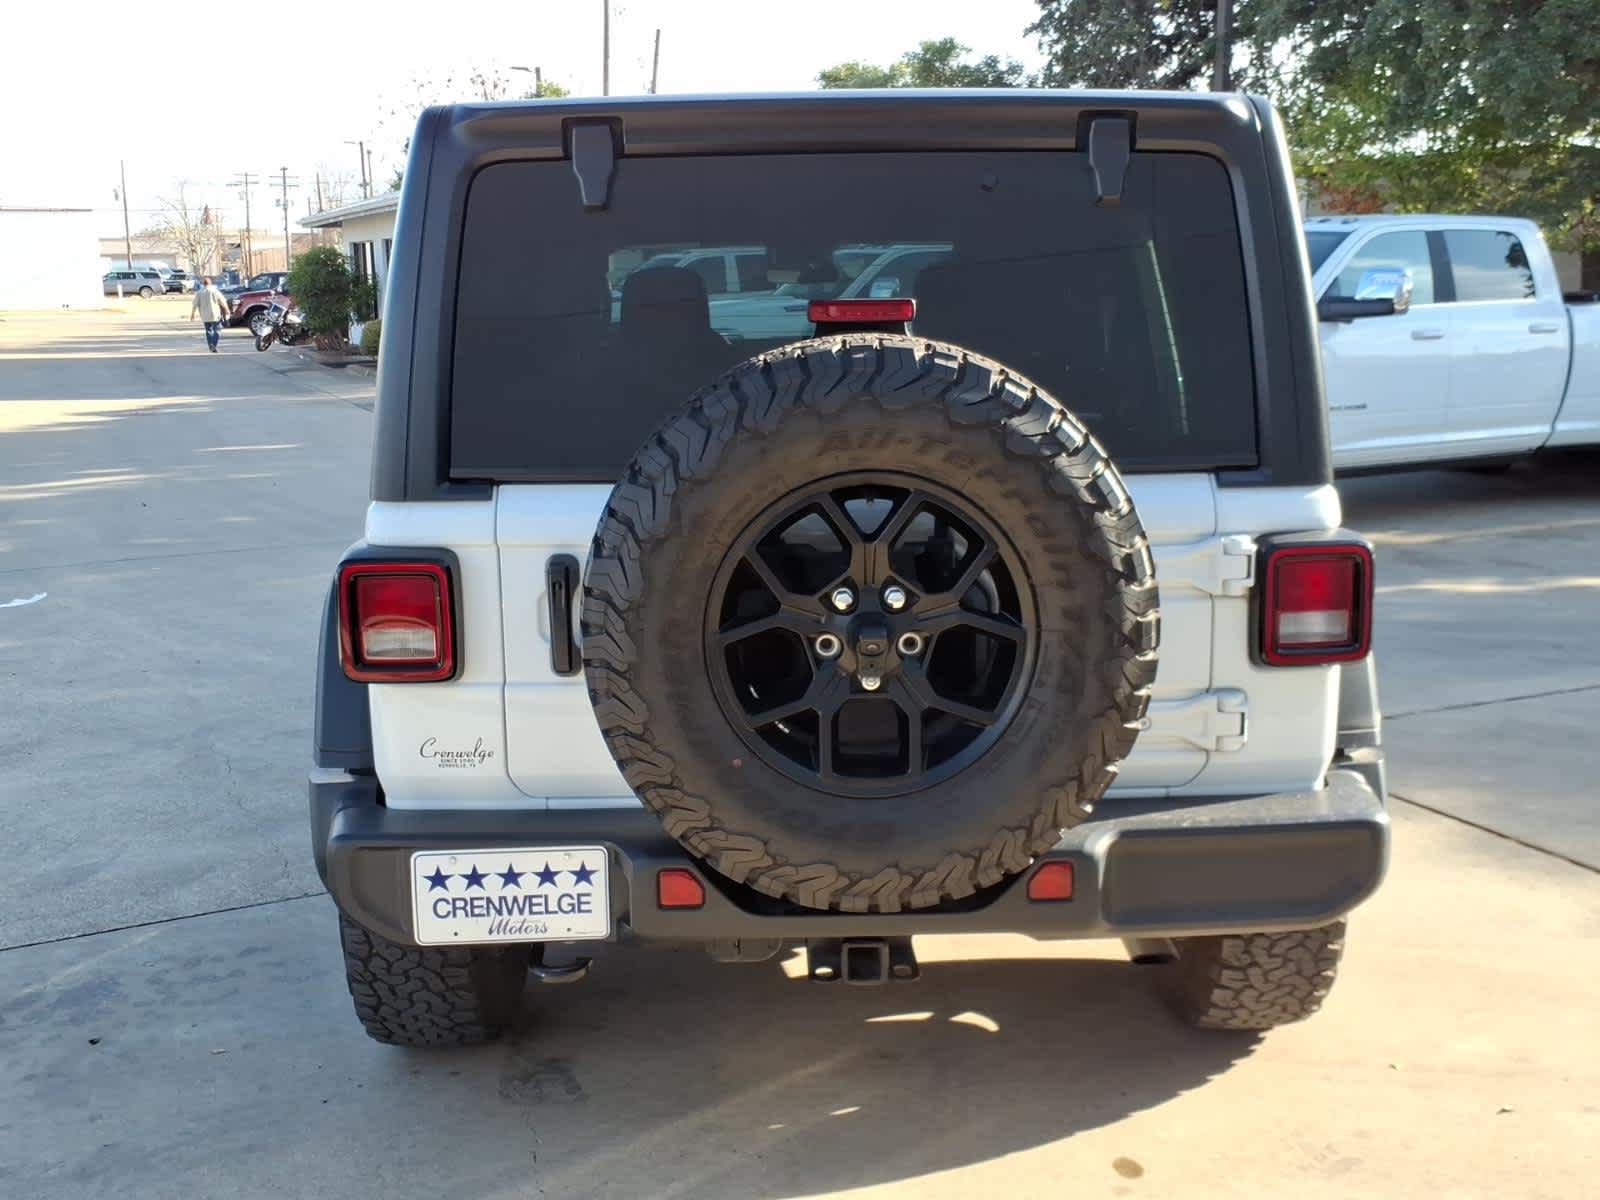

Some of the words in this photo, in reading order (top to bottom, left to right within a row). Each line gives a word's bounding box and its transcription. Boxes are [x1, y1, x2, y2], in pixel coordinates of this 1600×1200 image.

[419, 736, 495, 764] Crenwelge
[432, 892, 593, 919] CRENWELGE
[487, 913, 549, 936] Motors
